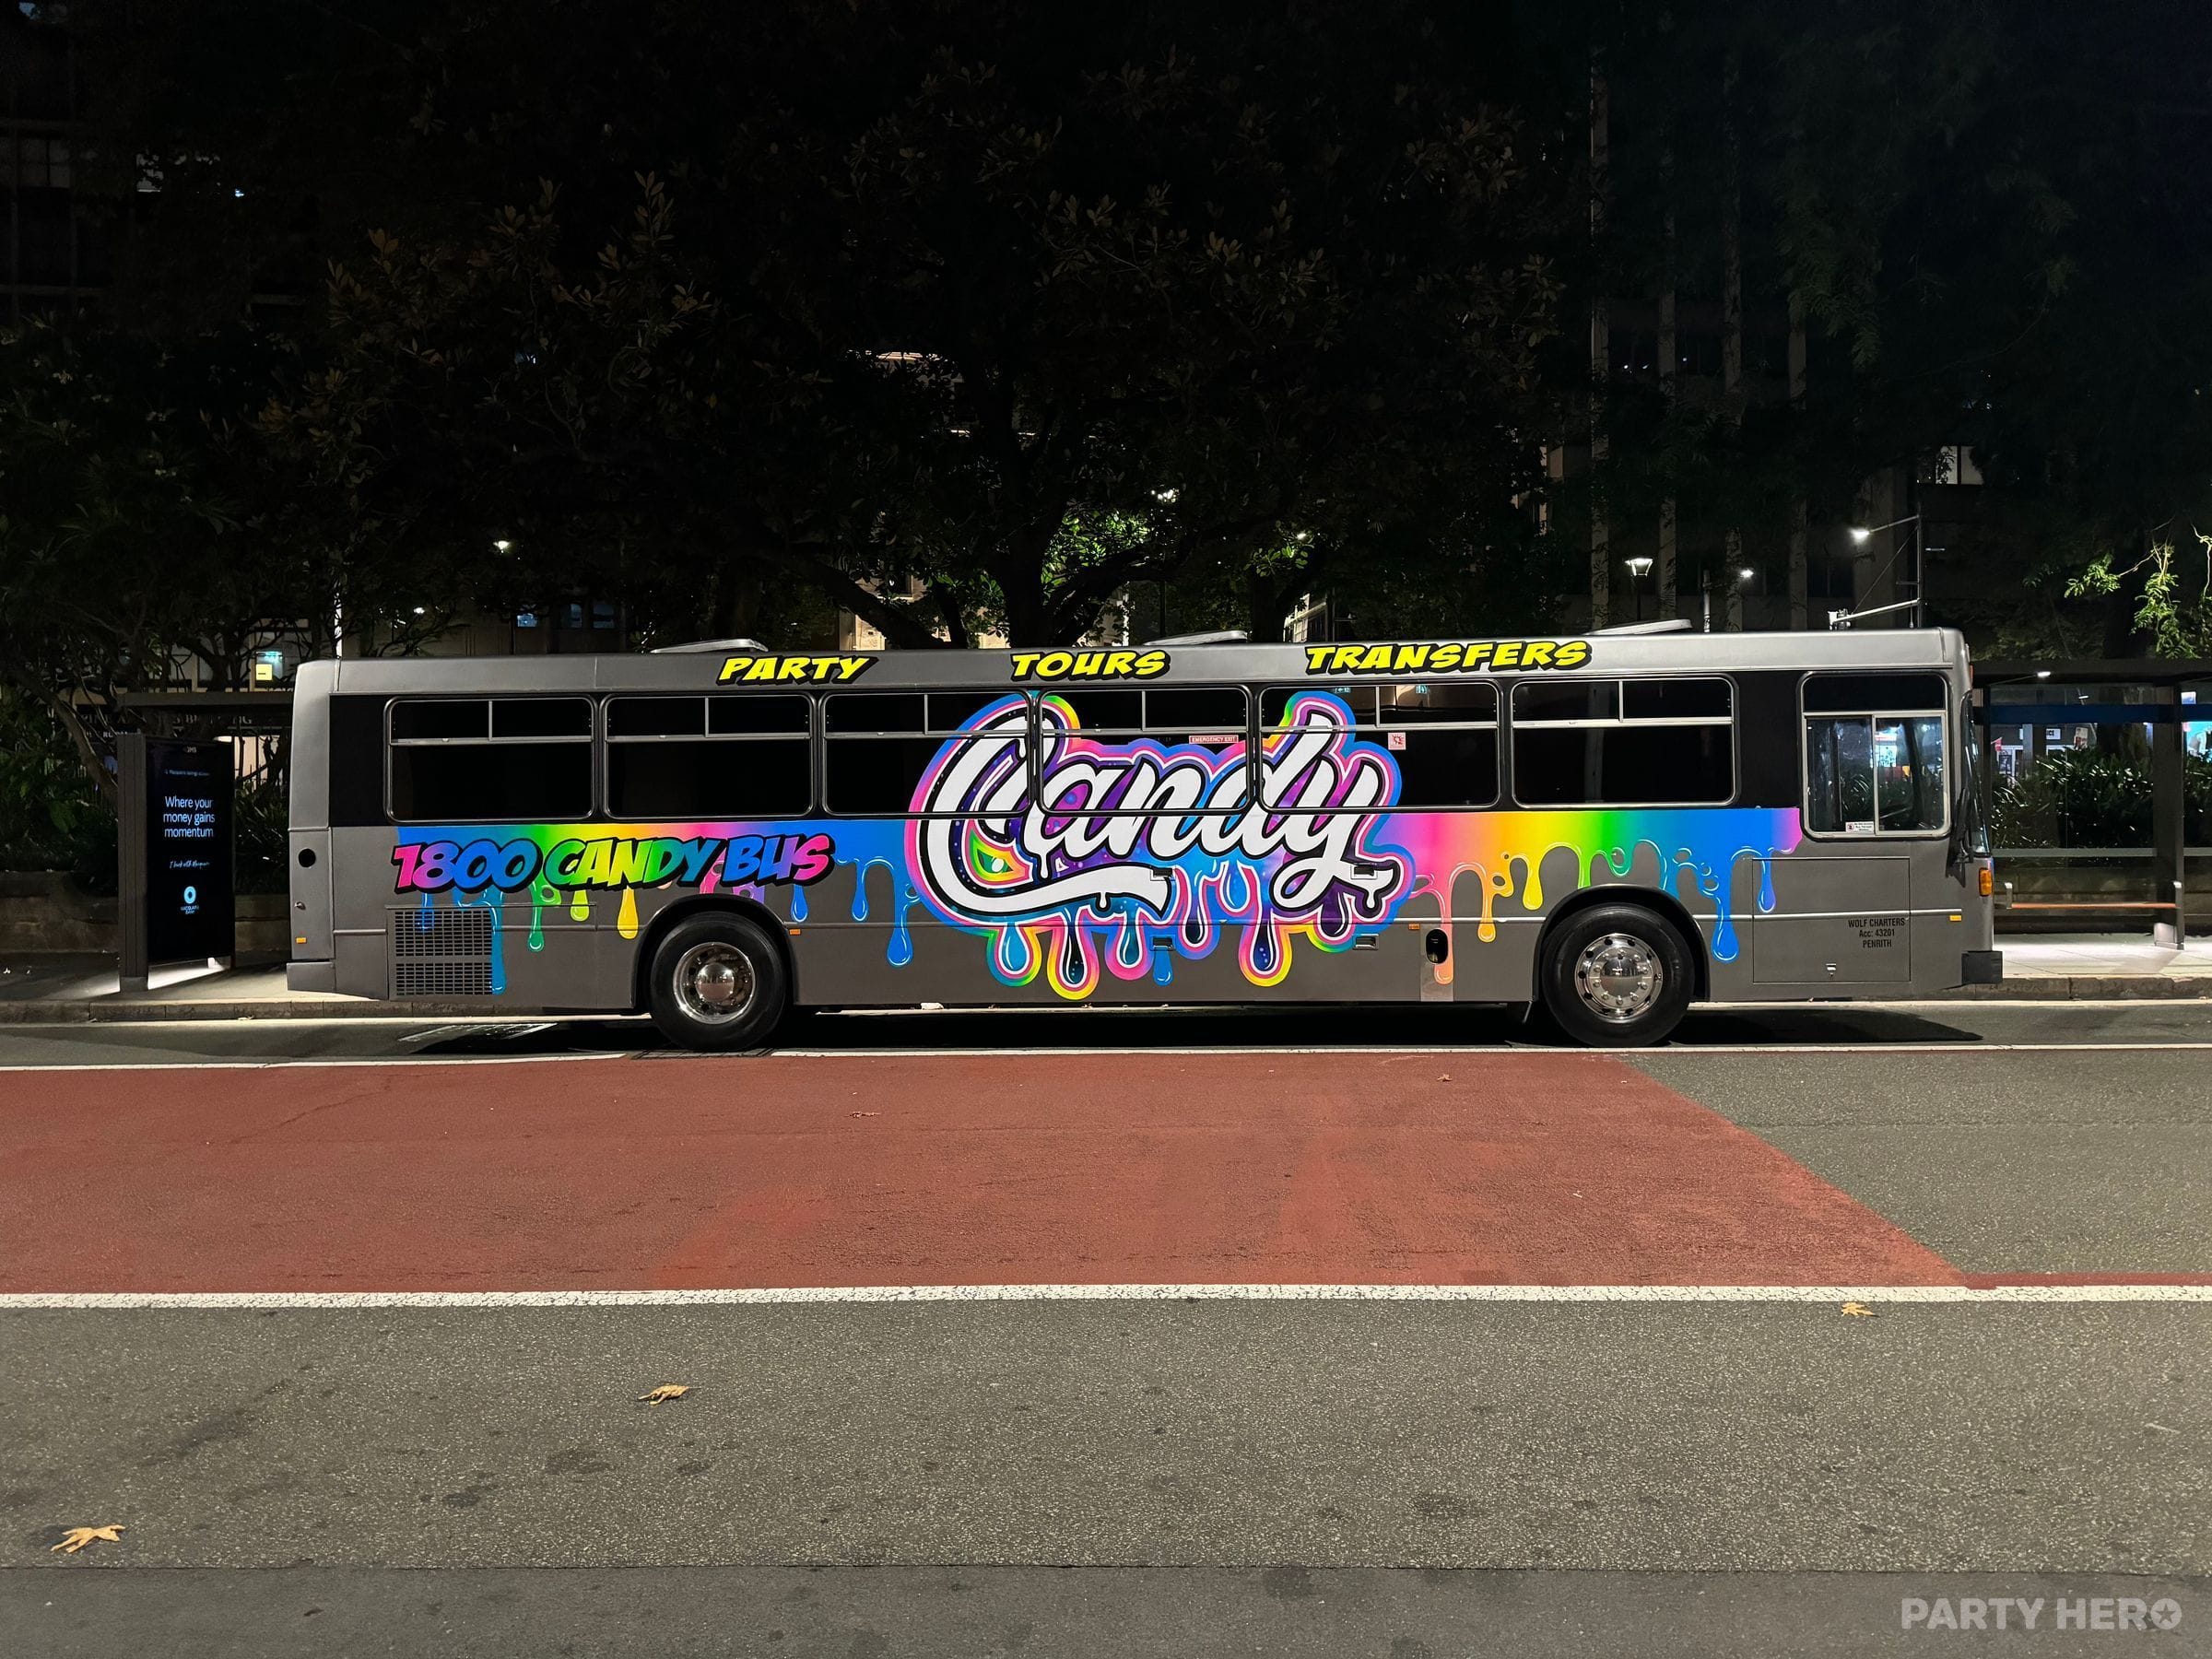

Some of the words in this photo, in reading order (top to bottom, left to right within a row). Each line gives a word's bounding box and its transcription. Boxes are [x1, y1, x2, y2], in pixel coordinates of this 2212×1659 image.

[1010, 650, 1170, 680] TOURS
[1305, 641, 1592, 675] TRANSFERS
[717, 655, 877, 685] PARTY
[164, 794, 194, 808] Where
[194, 798, 213, 811] your
[919, 706, 1399, 915] Candy
[163, 813, 193, 826] money
[194, 811, 216, 826] gains
[164, 827, 214, 838] momentum
[392, 839, 541, 893] 1800
[544, 835, 726, 891] CANDY
[722, 833, 834, 886] BUS
[1848, 919, 1868, 928] WOLF
[1869, 917, 1905, 927] CHARTERS
[1859, 929, 1874, 938] Acc:
[1875, 928, 1895, 937] 43201
[1862, 938, 1892, 948] PENRITH
